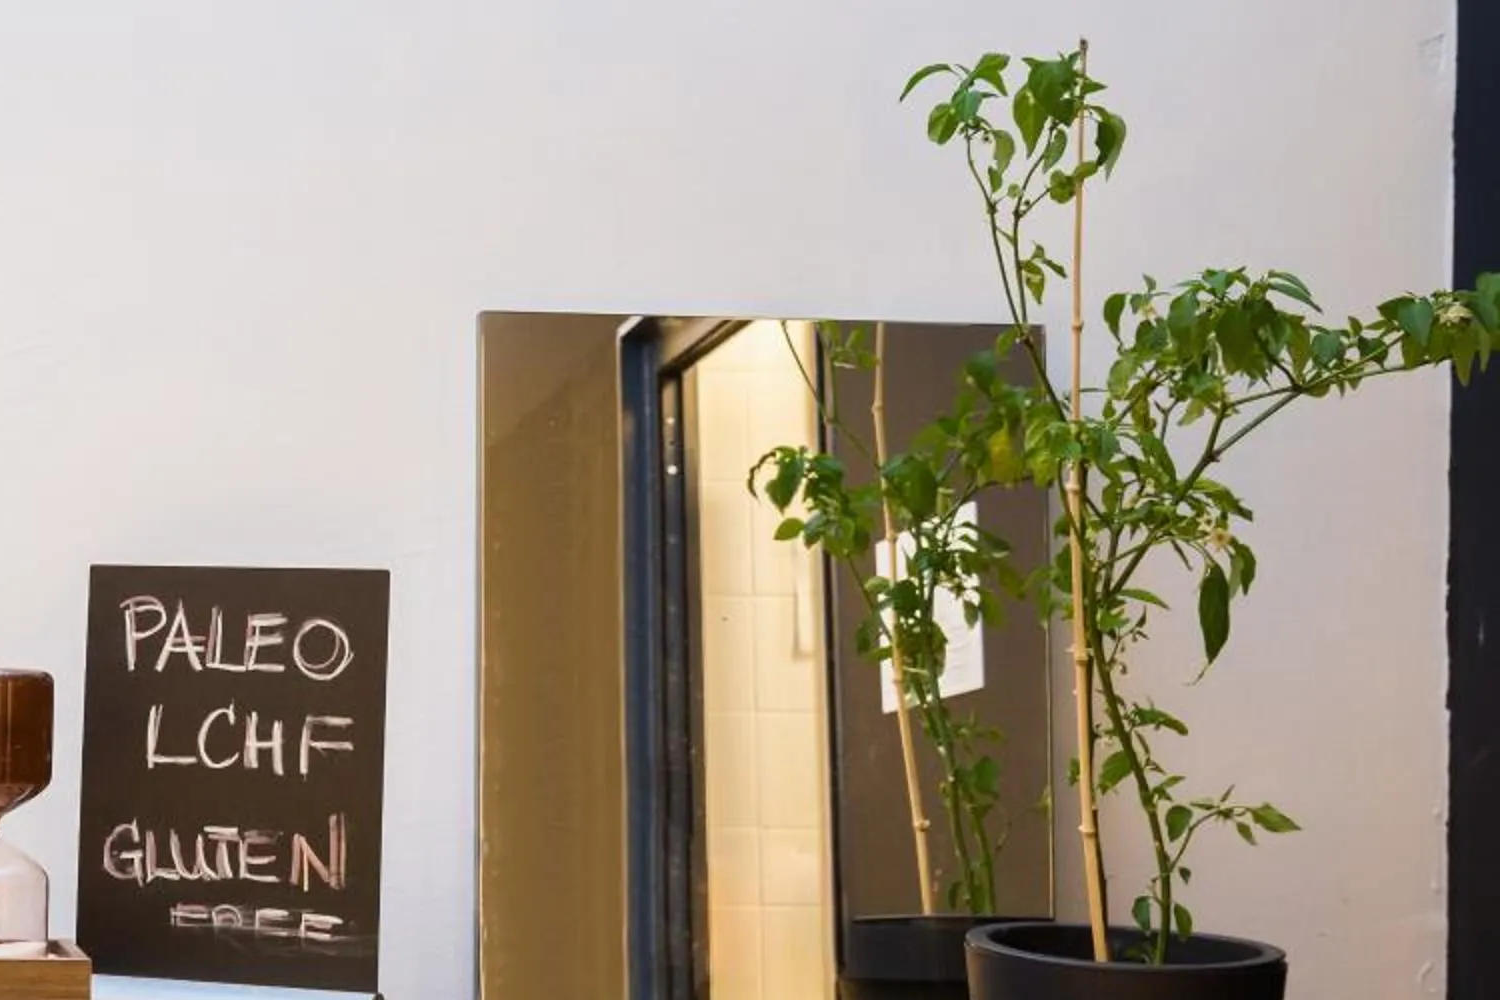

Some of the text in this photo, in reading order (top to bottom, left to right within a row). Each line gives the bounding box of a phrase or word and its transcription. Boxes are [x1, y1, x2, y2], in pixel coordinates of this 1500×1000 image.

[120, 595, 355, 681] PALEO
[145, 700, 354, 781] LCHF
[102, 813, 348, 892] GLUTEN
